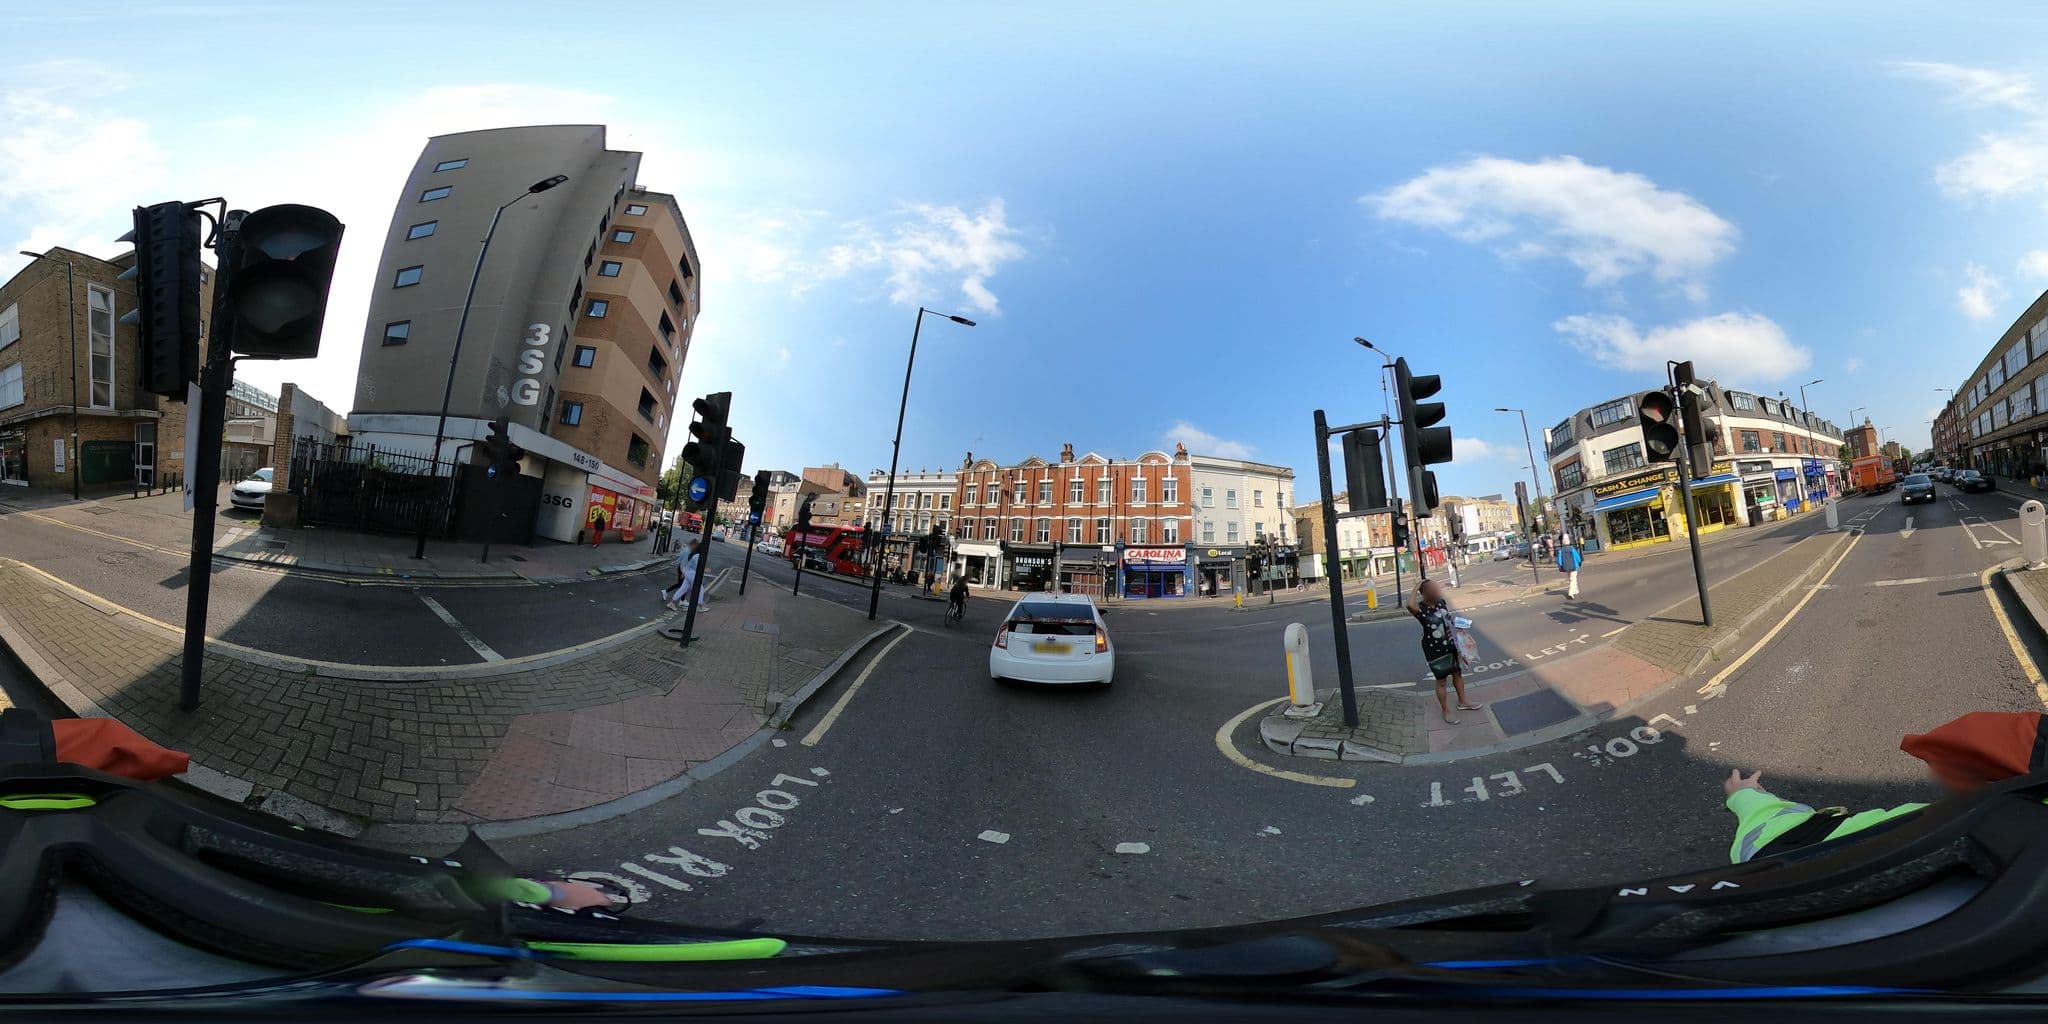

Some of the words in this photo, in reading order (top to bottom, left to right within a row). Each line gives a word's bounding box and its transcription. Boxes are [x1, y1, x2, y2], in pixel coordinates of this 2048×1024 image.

[511, 322, 551, 406] 3SG
[1596, 484, 1619, 494] CASH
[1628, 474, 1664, 487] CHANGE
[543, 494, 573, 509] 3SG
[1128, 550, 1182, 558] CAROLINA
[1526, 634, 1590, 660] LEFT
[1420, 763, 1566, 808] LEFT
[697, 774, 819, 850] LOOK
